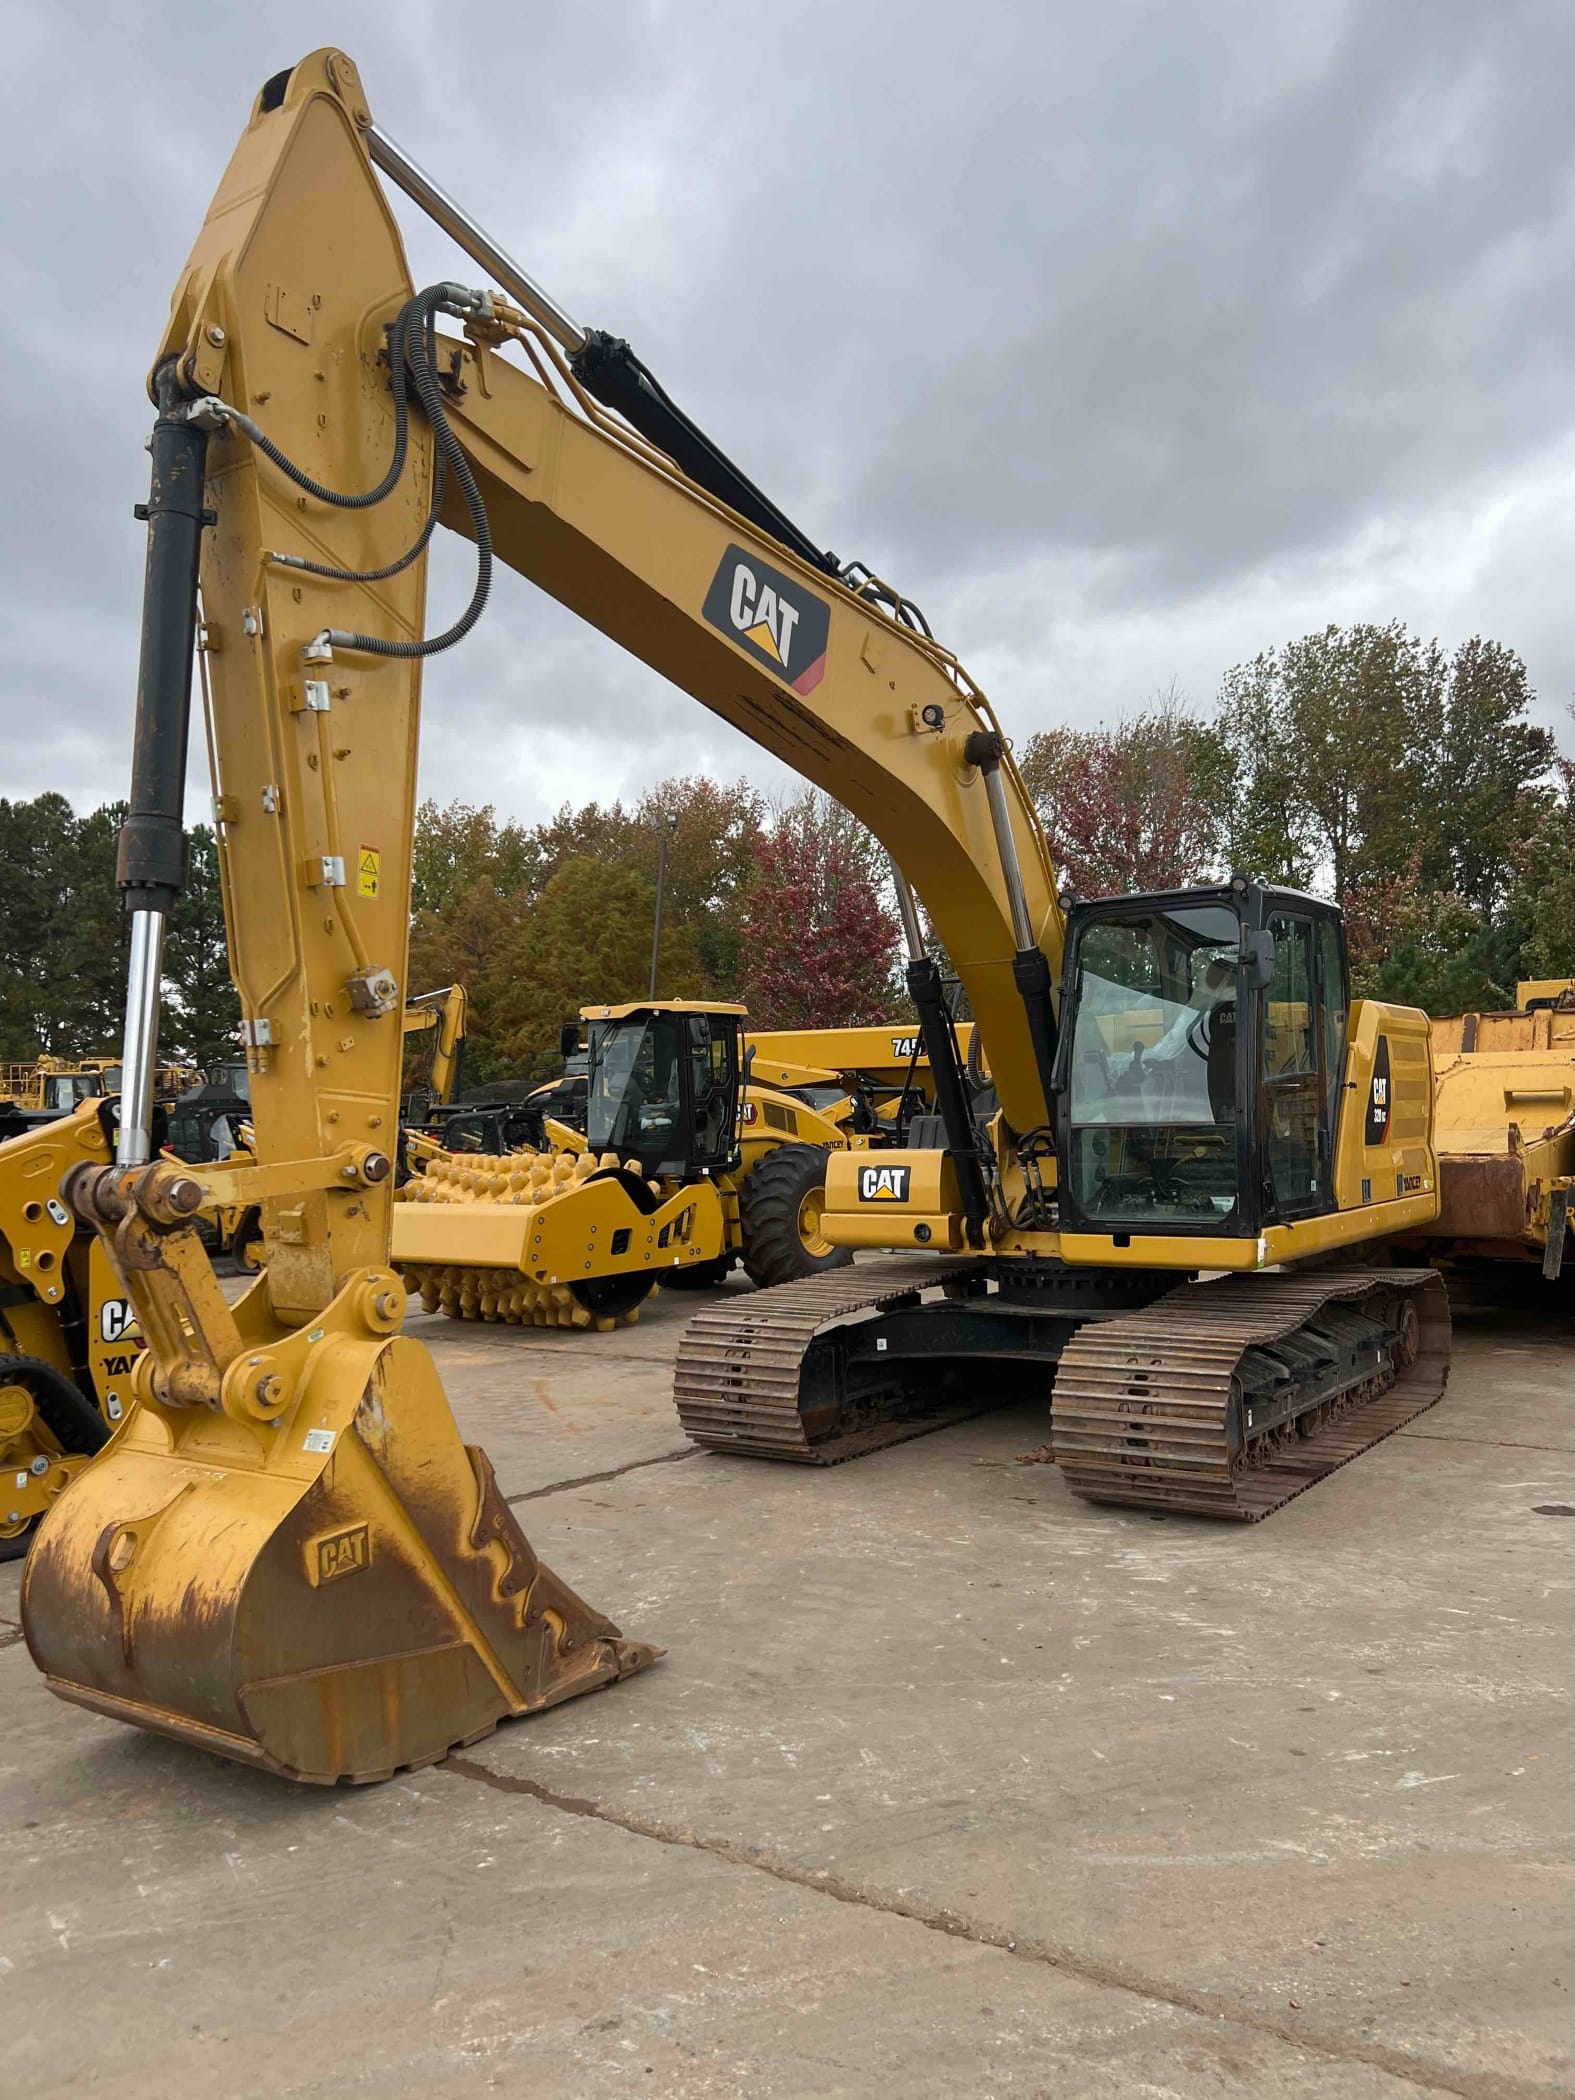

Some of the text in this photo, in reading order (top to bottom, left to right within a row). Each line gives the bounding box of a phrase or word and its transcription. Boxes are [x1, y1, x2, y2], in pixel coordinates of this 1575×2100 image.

[730, 563, 800, 668] CAT
[1373, 1077, 1387, 1105] CAT
[863, 1169, 905, 1199] CAT
[102, 1300, 137, 1342] CA
[321, 1531, 367, 1579] CAT
